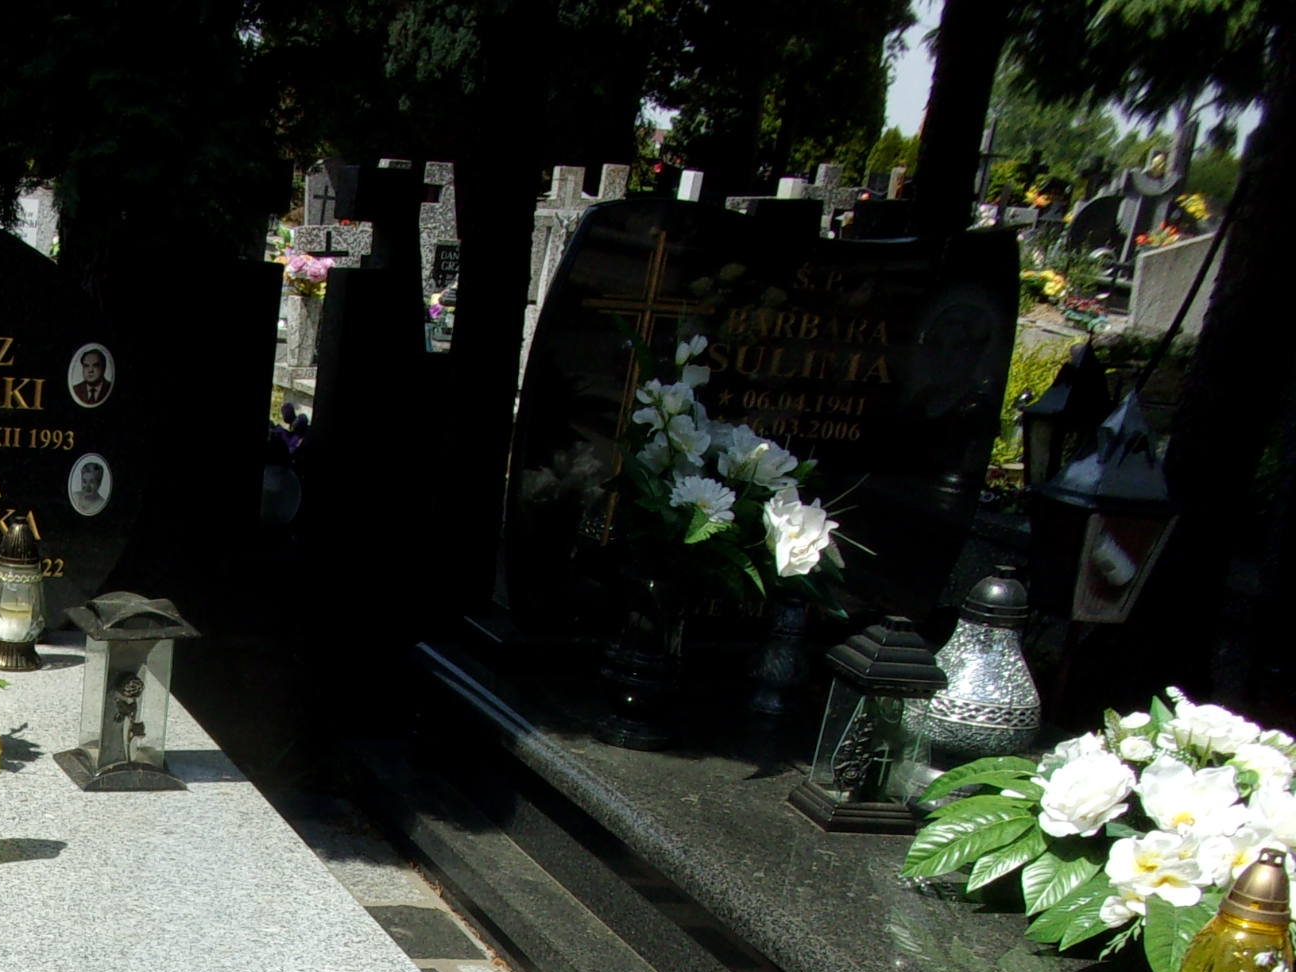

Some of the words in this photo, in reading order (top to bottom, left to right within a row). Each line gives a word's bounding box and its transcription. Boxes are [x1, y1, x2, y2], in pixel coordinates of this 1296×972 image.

[726, 307, 890, 345] BARBARA
[29, 429, 75, 451] 1993
[42, 558, 65, 577] 22
